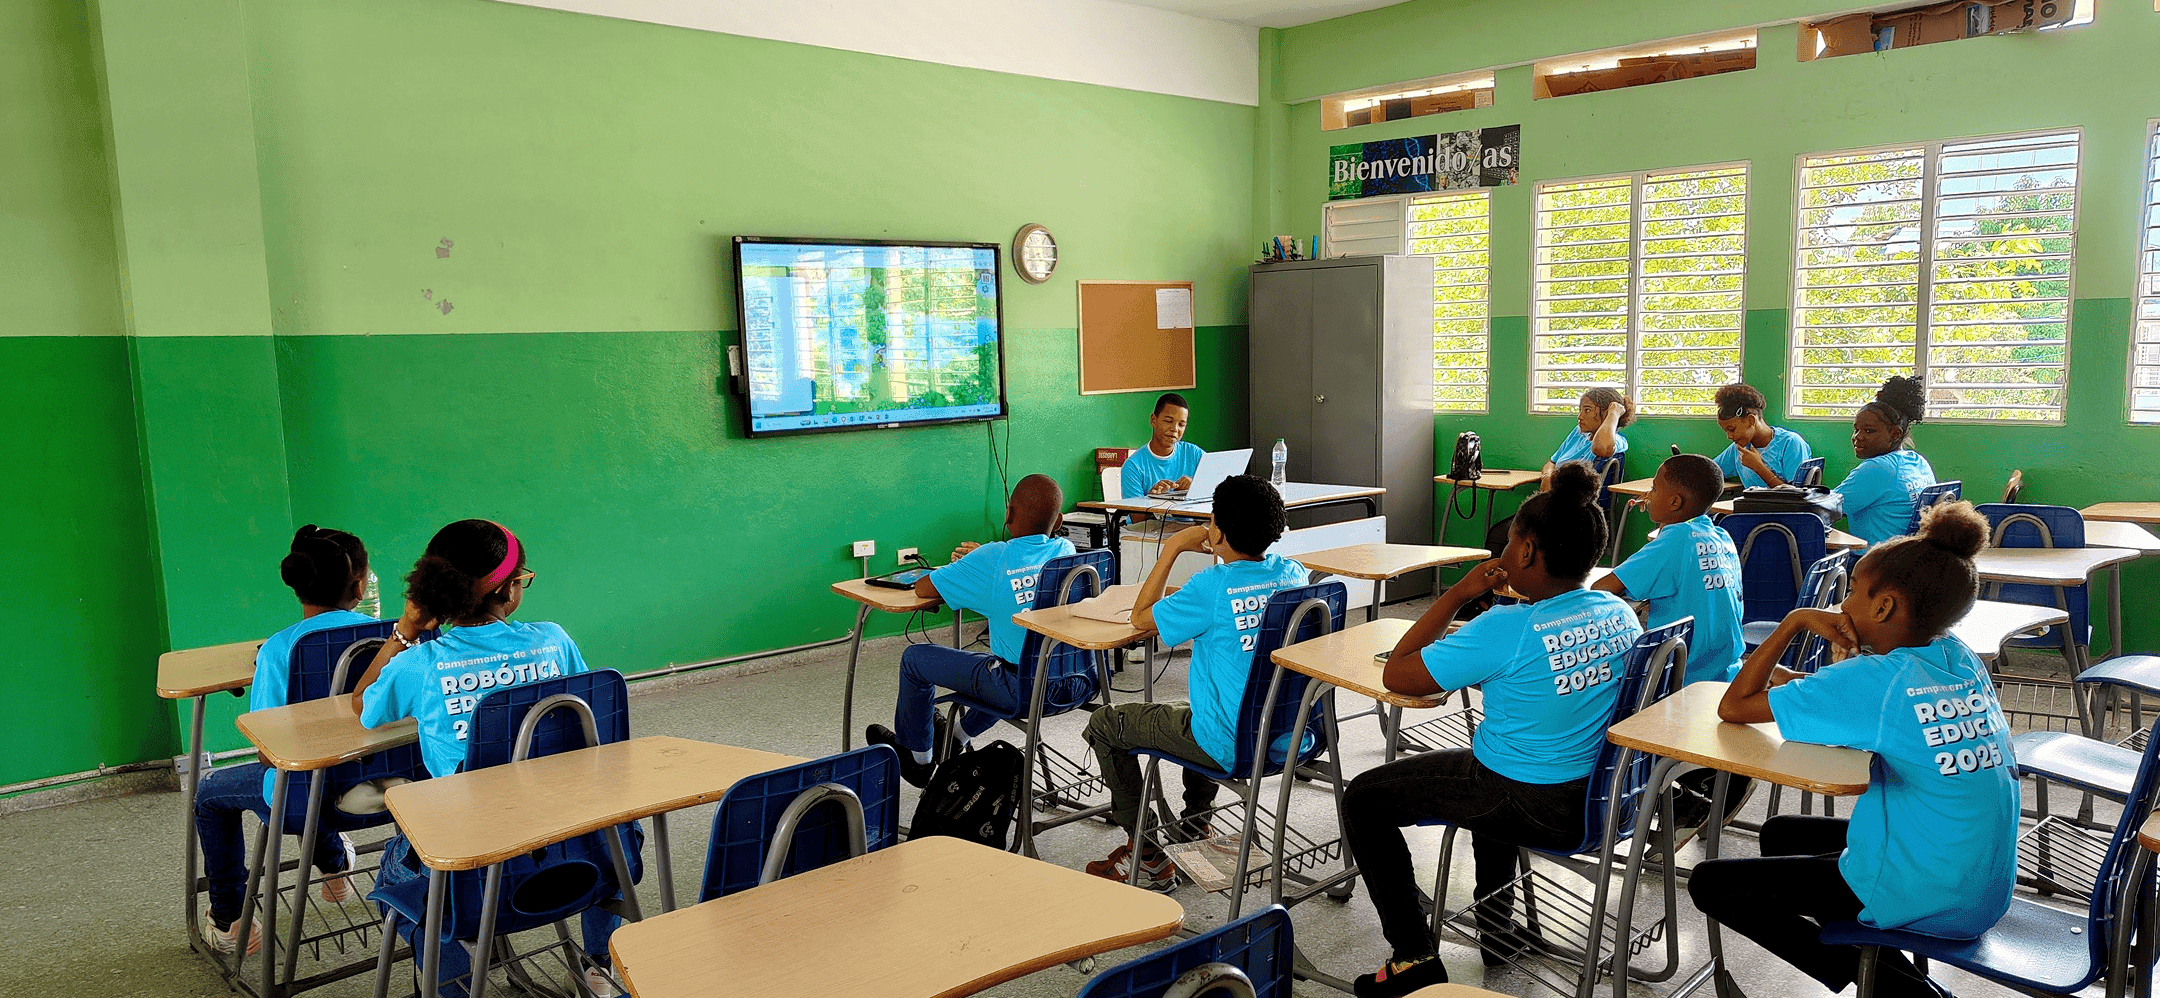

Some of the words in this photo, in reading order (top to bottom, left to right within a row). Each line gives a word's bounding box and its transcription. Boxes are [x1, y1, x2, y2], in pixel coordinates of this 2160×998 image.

[1333, 144, 1513, 183] Bienvenido/as
[1541, 611, 1635, 654] ROBÓTICA
[436, 653, 509, 671] Campamento
[513, 650, 527, 659] de
[440, 659, 562, 696] ROBÓTICA
[1554, 661, 1613, 696] 2025
[1934, 742, 2004, 776] 2025
